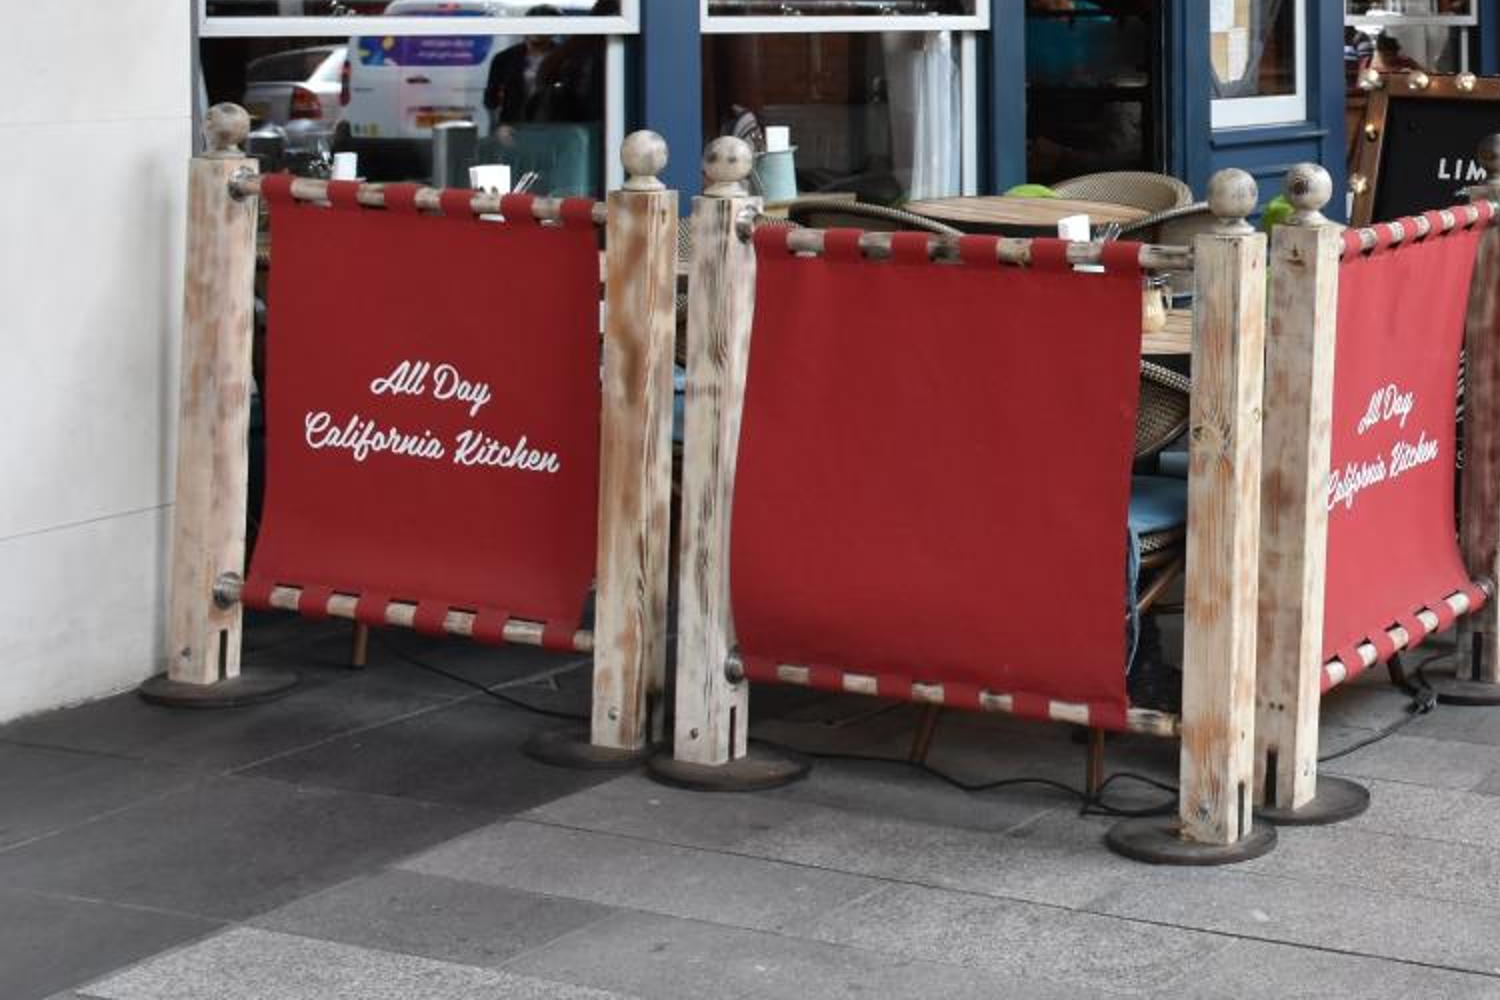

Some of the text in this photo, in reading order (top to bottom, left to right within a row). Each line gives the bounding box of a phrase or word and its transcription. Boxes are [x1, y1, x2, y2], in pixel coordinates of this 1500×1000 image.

[370, 359, 492, 417] All Day
[1358, 383, 1415, 435] All Day
[305, 410, 561, 473] California Kitchen
[1327, 430, 1439, 511] California Kitchen
